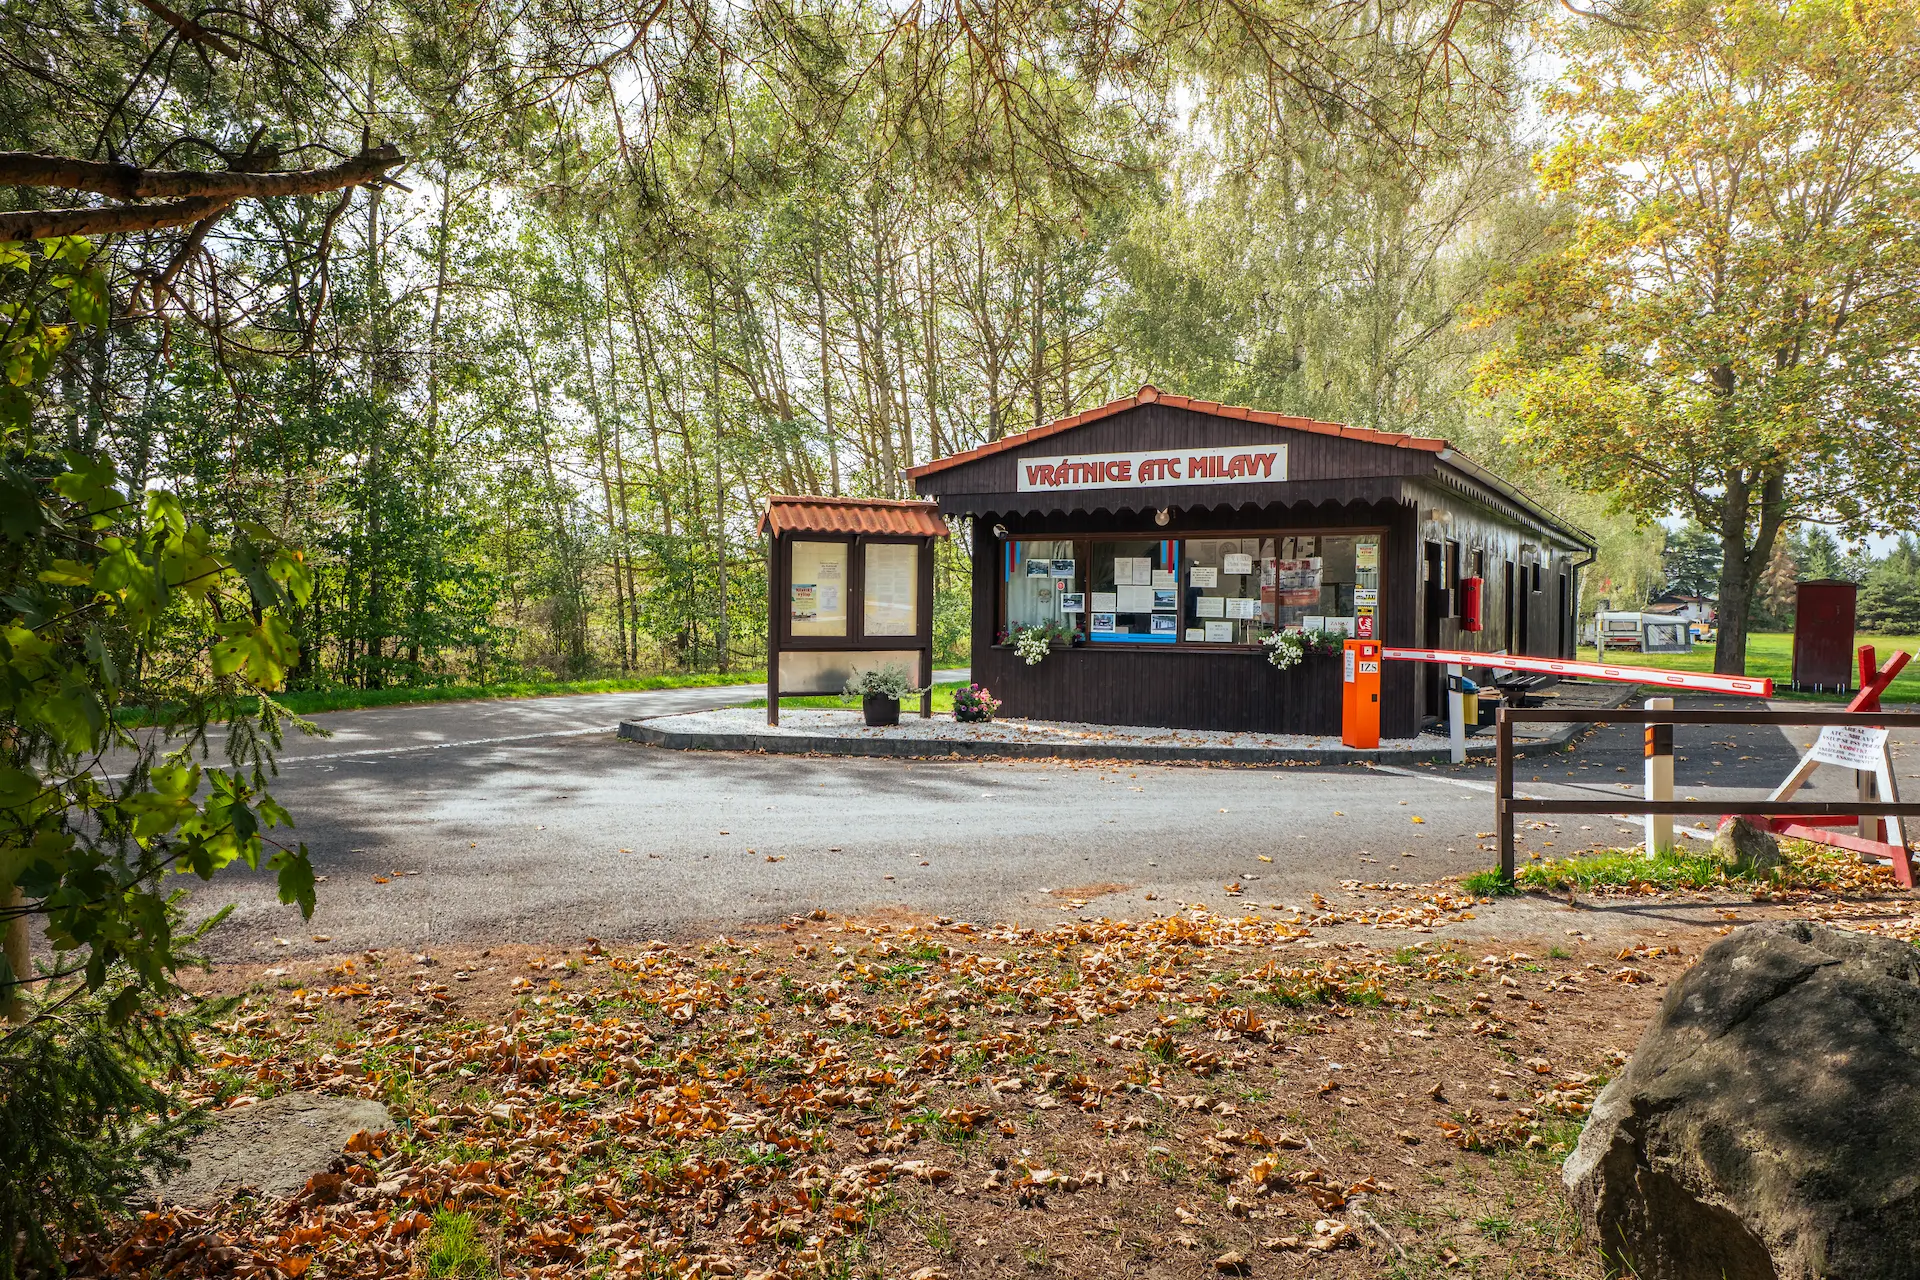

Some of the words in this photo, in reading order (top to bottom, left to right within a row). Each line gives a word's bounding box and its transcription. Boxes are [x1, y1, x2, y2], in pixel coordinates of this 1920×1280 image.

[1025, 459, 1131, 487] VRÁTNICE
[1138, 457, 1181, 484] ATC
[1188, 452, 1277, 479] MILAVY
[1361, 663, 1377, 672] IZS
